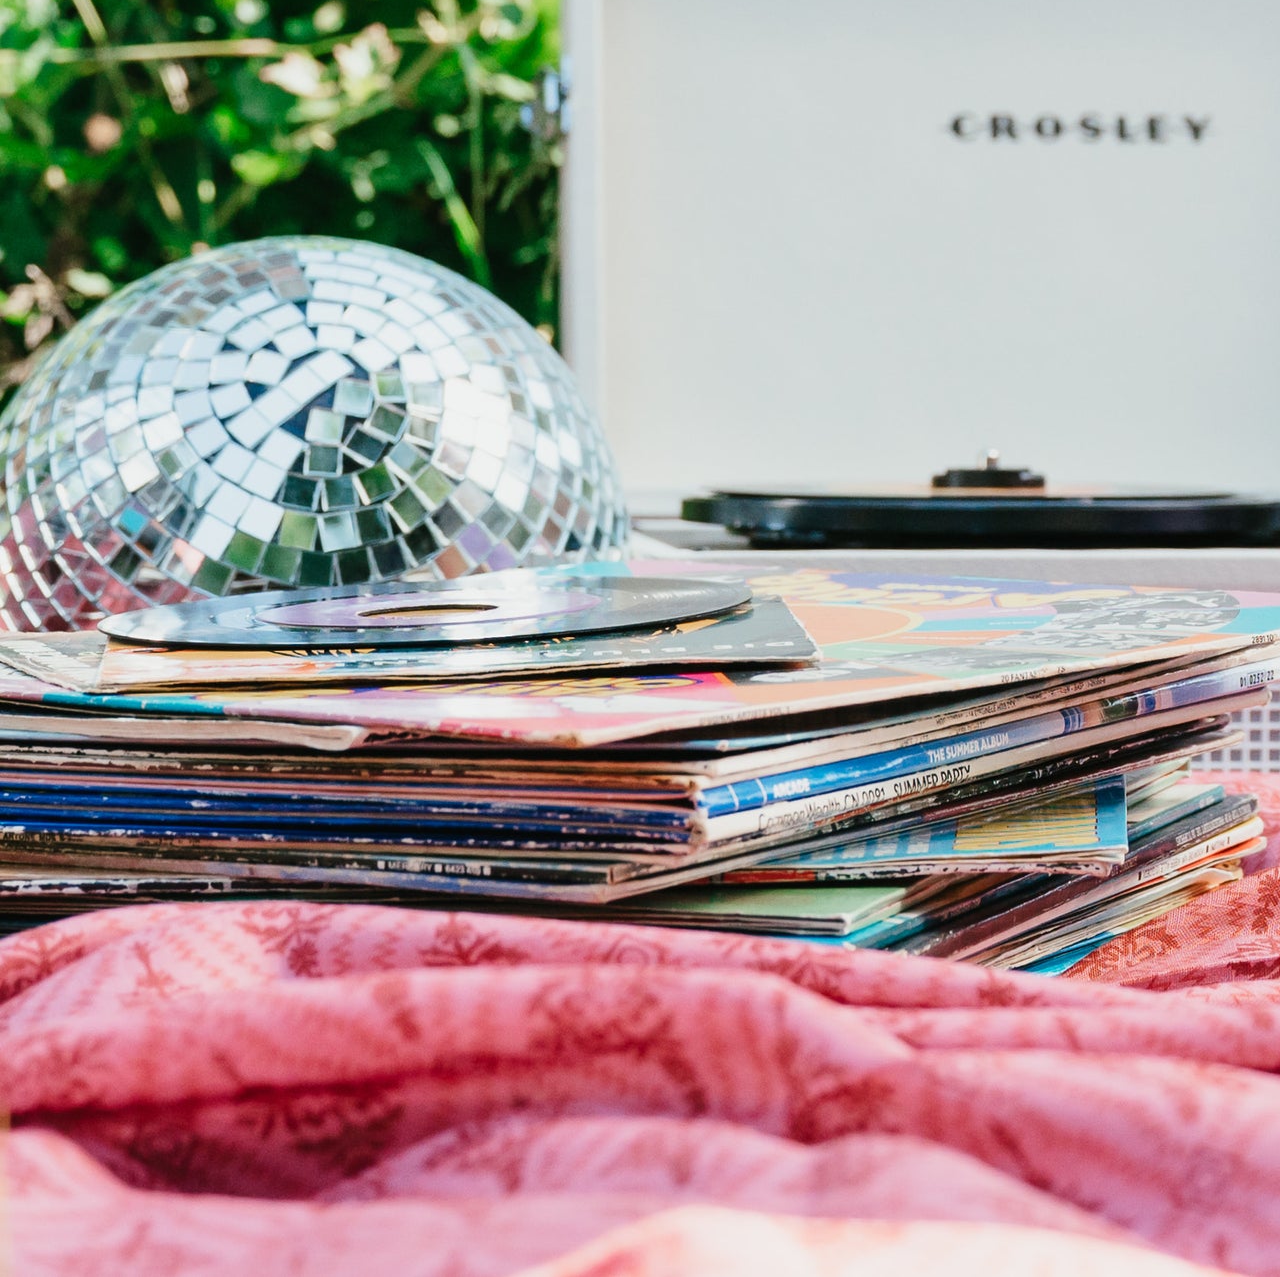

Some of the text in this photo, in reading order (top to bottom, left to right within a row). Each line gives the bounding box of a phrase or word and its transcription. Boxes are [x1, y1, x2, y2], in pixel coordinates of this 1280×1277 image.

[952, 113, 1210, 141] CROSLEY
[927, 749, 946, 763] THE
[946, 741, 980, 758] SUMMER
[981, 733, 1009, 750] ALBUM
[893, 773, 939, 796] SUMMER
[940, 765, 971, 784] PARTY
